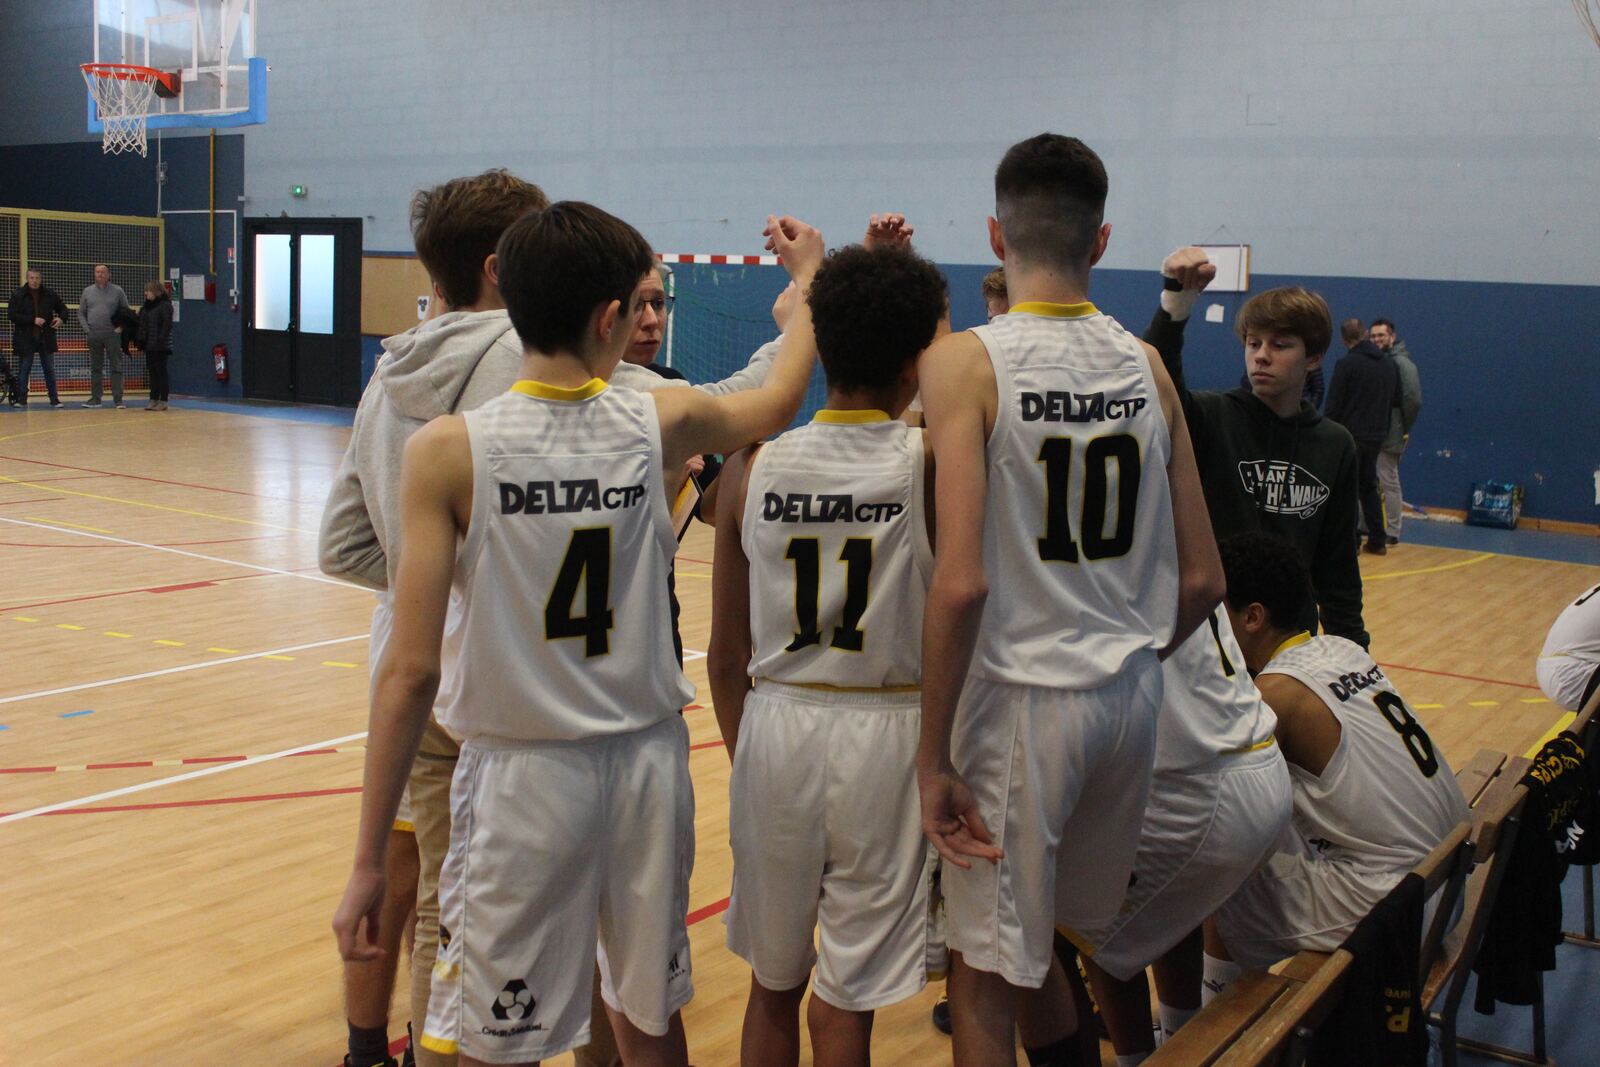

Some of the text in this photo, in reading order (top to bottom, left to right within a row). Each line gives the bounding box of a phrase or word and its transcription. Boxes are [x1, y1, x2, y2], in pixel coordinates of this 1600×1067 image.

[1037, 433, 1142, 564] 10
[1254, 464, 1296, 484] VANS
[544, 526, 615, 659] 4
[785, 536, 874, 653] 11
[1373, 690, 1439, 778] 8
